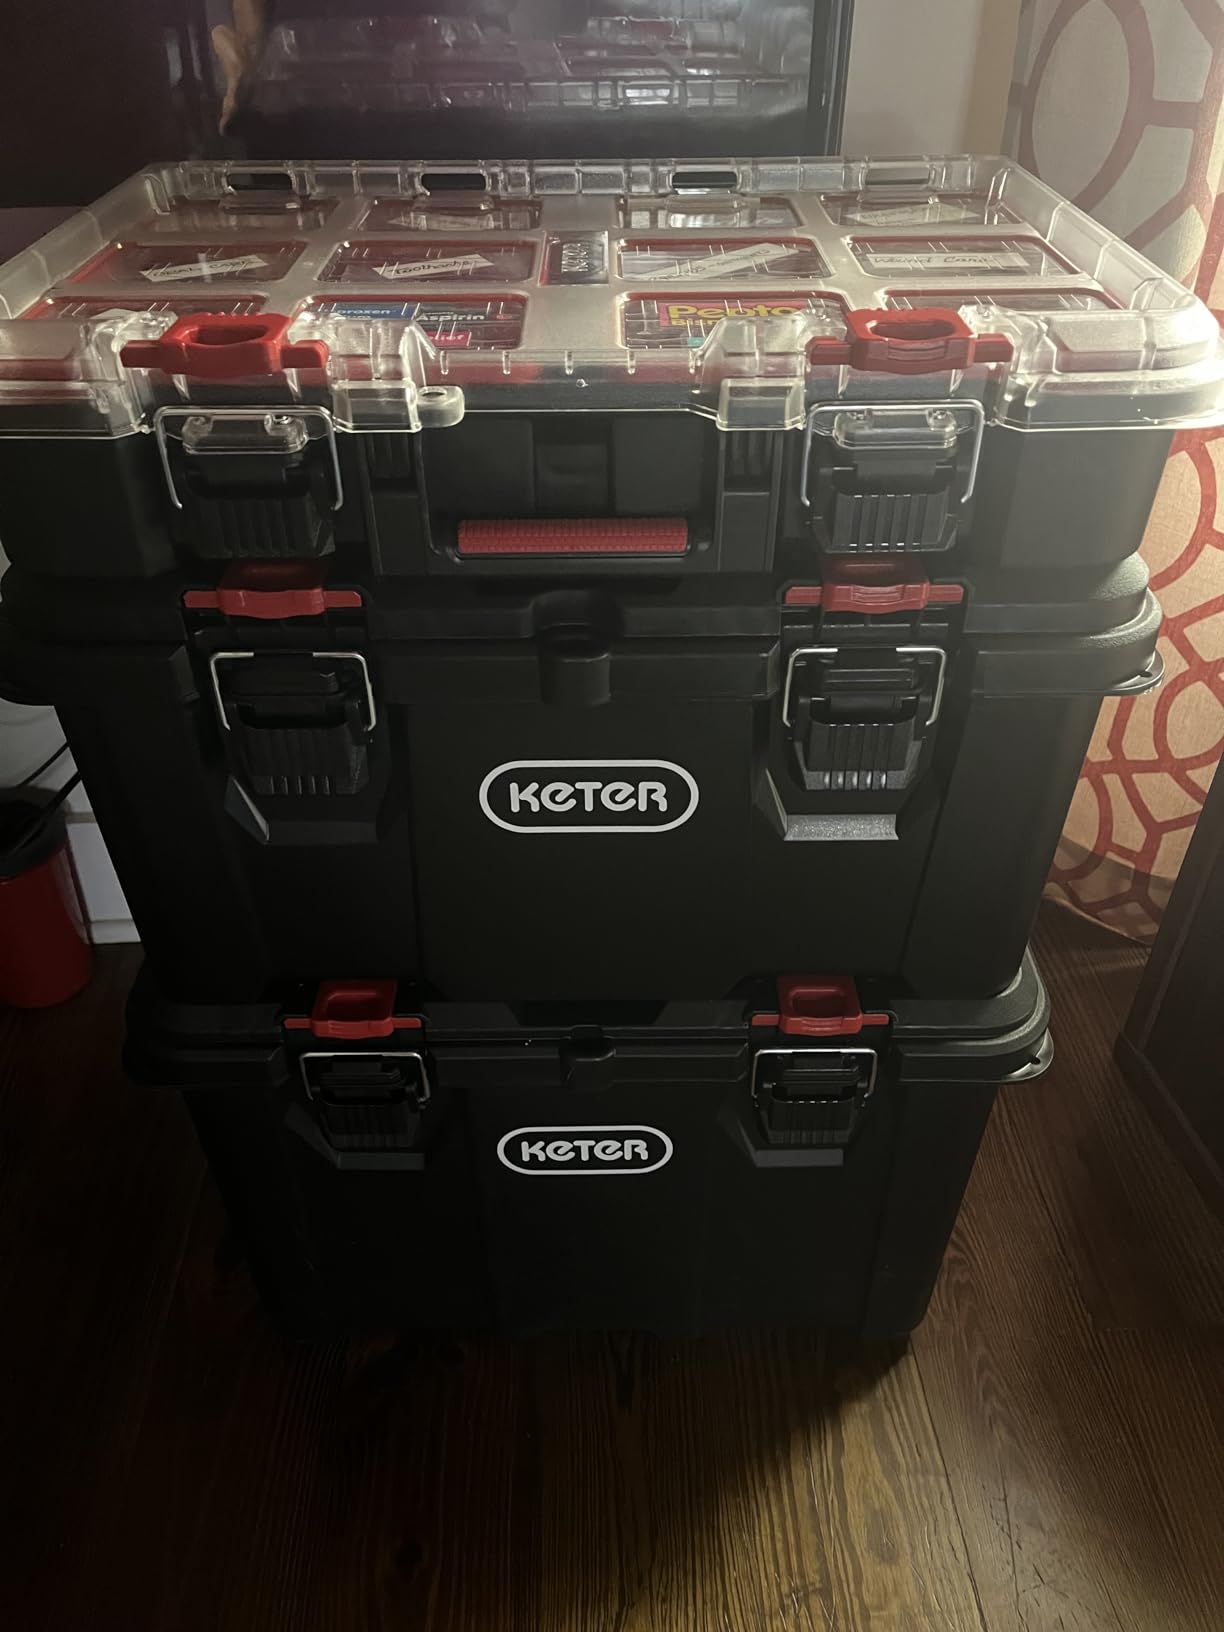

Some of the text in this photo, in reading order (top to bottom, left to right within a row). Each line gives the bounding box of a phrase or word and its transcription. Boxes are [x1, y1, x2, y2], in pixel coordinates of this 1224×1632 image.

[416, 313, 485, 322] Aspirin
[667, 304, 802, 319] Pepto
[509, 781, 668, 813] KETER
[521, 1139, 649, 1162] KETER
